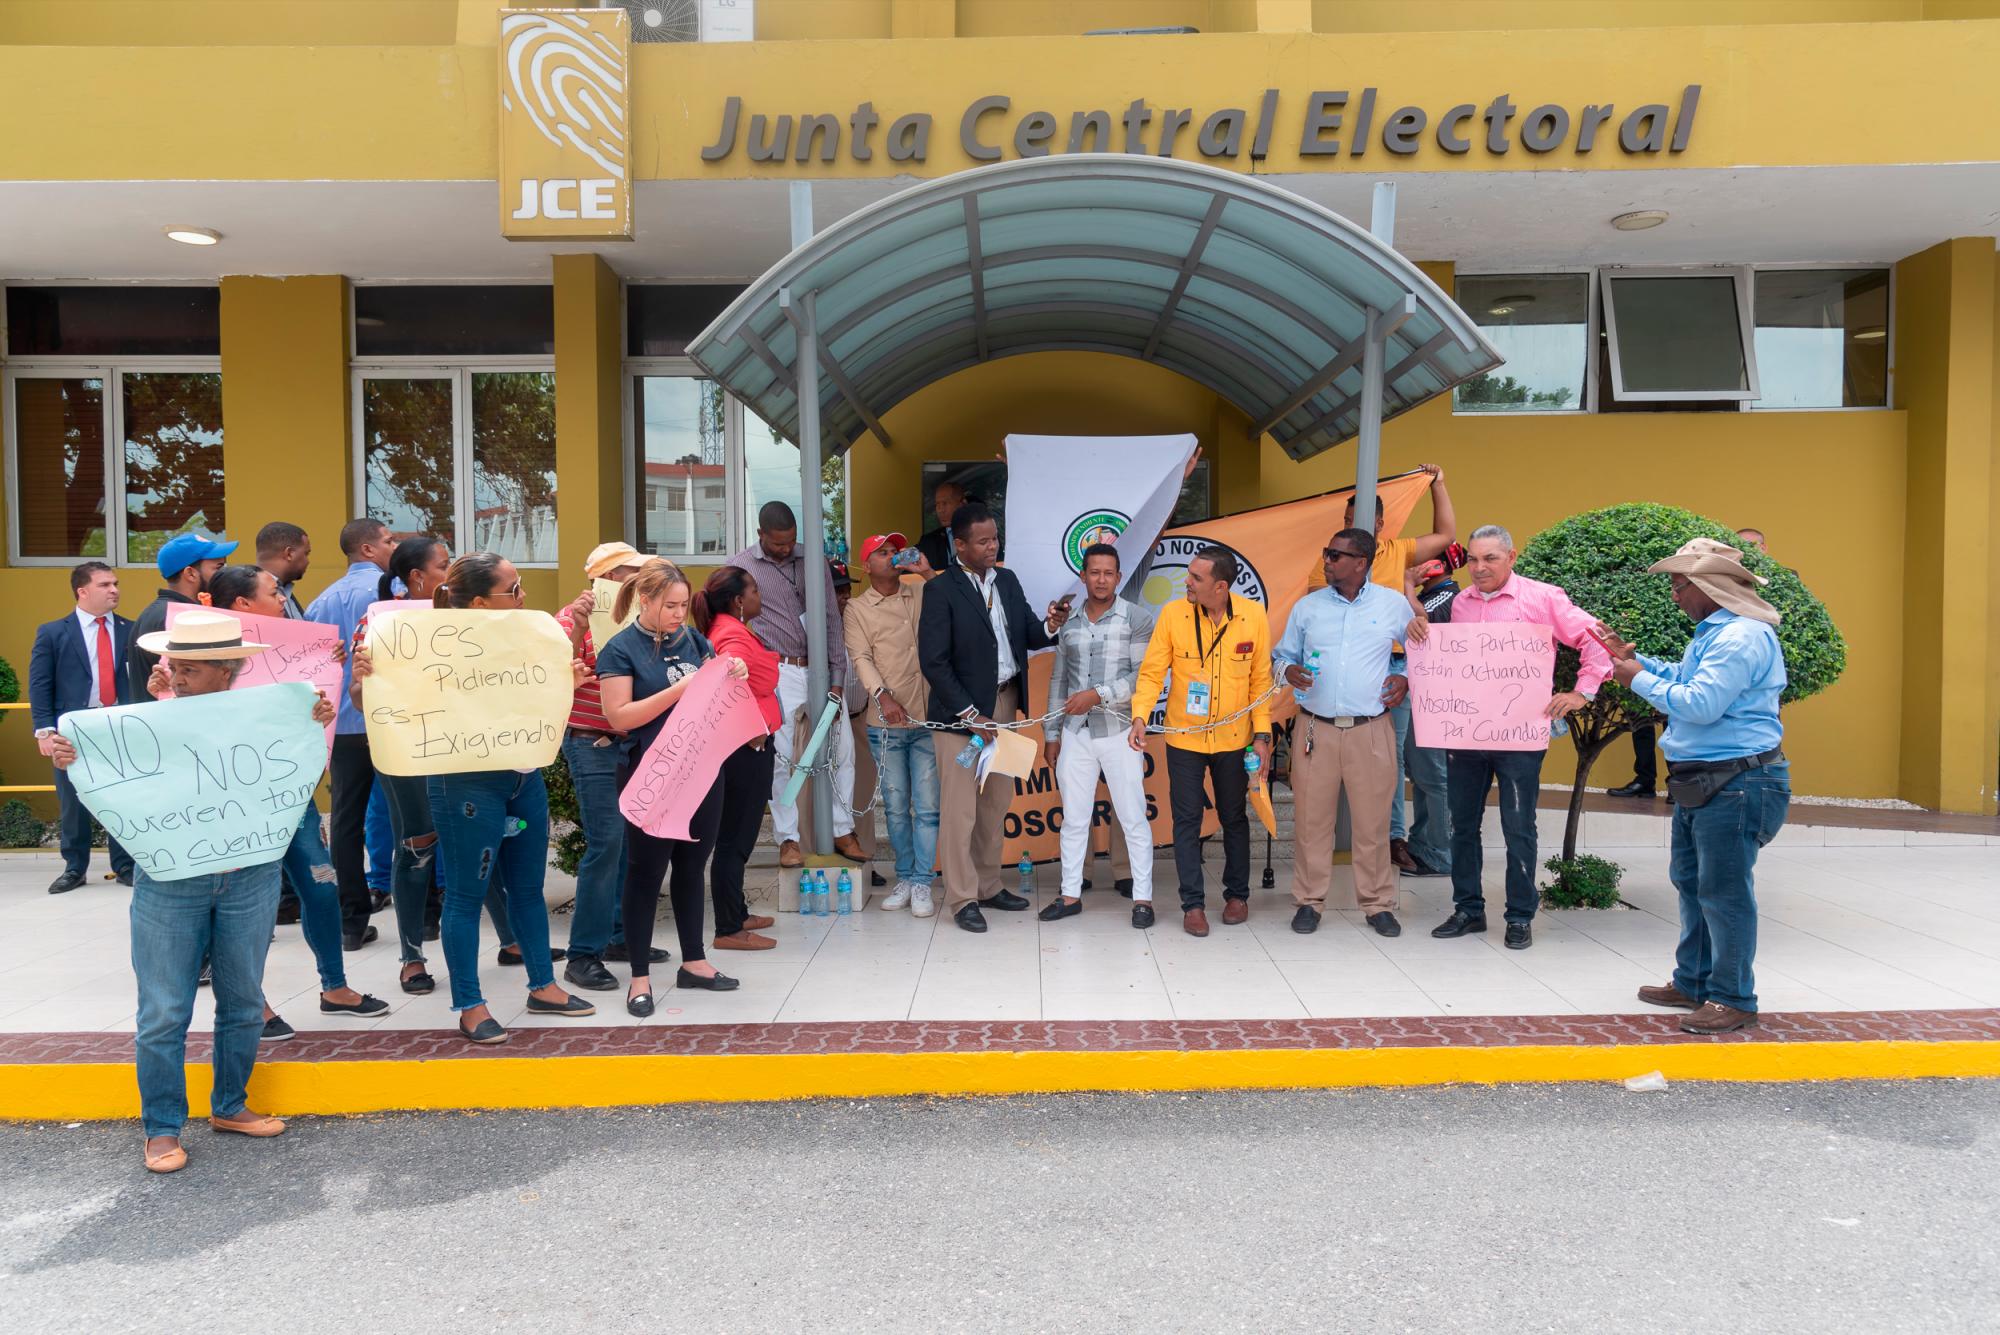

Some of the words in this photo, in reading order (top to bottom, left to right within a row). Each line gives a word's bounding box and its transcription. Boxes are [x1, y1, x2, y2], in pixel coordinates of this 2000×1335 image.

[701, 96, 932, 164] Junta
[960, 88, 1279, 162] Central
[1300, 85, 1701, 156] Electoral
[512, 179, 616, 219] JCE
[369, 617, 418, 660] NO
[431, 625, 484, 657] es
[422, 662, 547, 692] Pidiendo
[371, 706, 411, 725] es
[1500, 683, 1523, 716] ?
[69, 714, 161, 783] NO
[183, 739, 299, 795] NOS
[97, 799, 246, 841] Quieren
